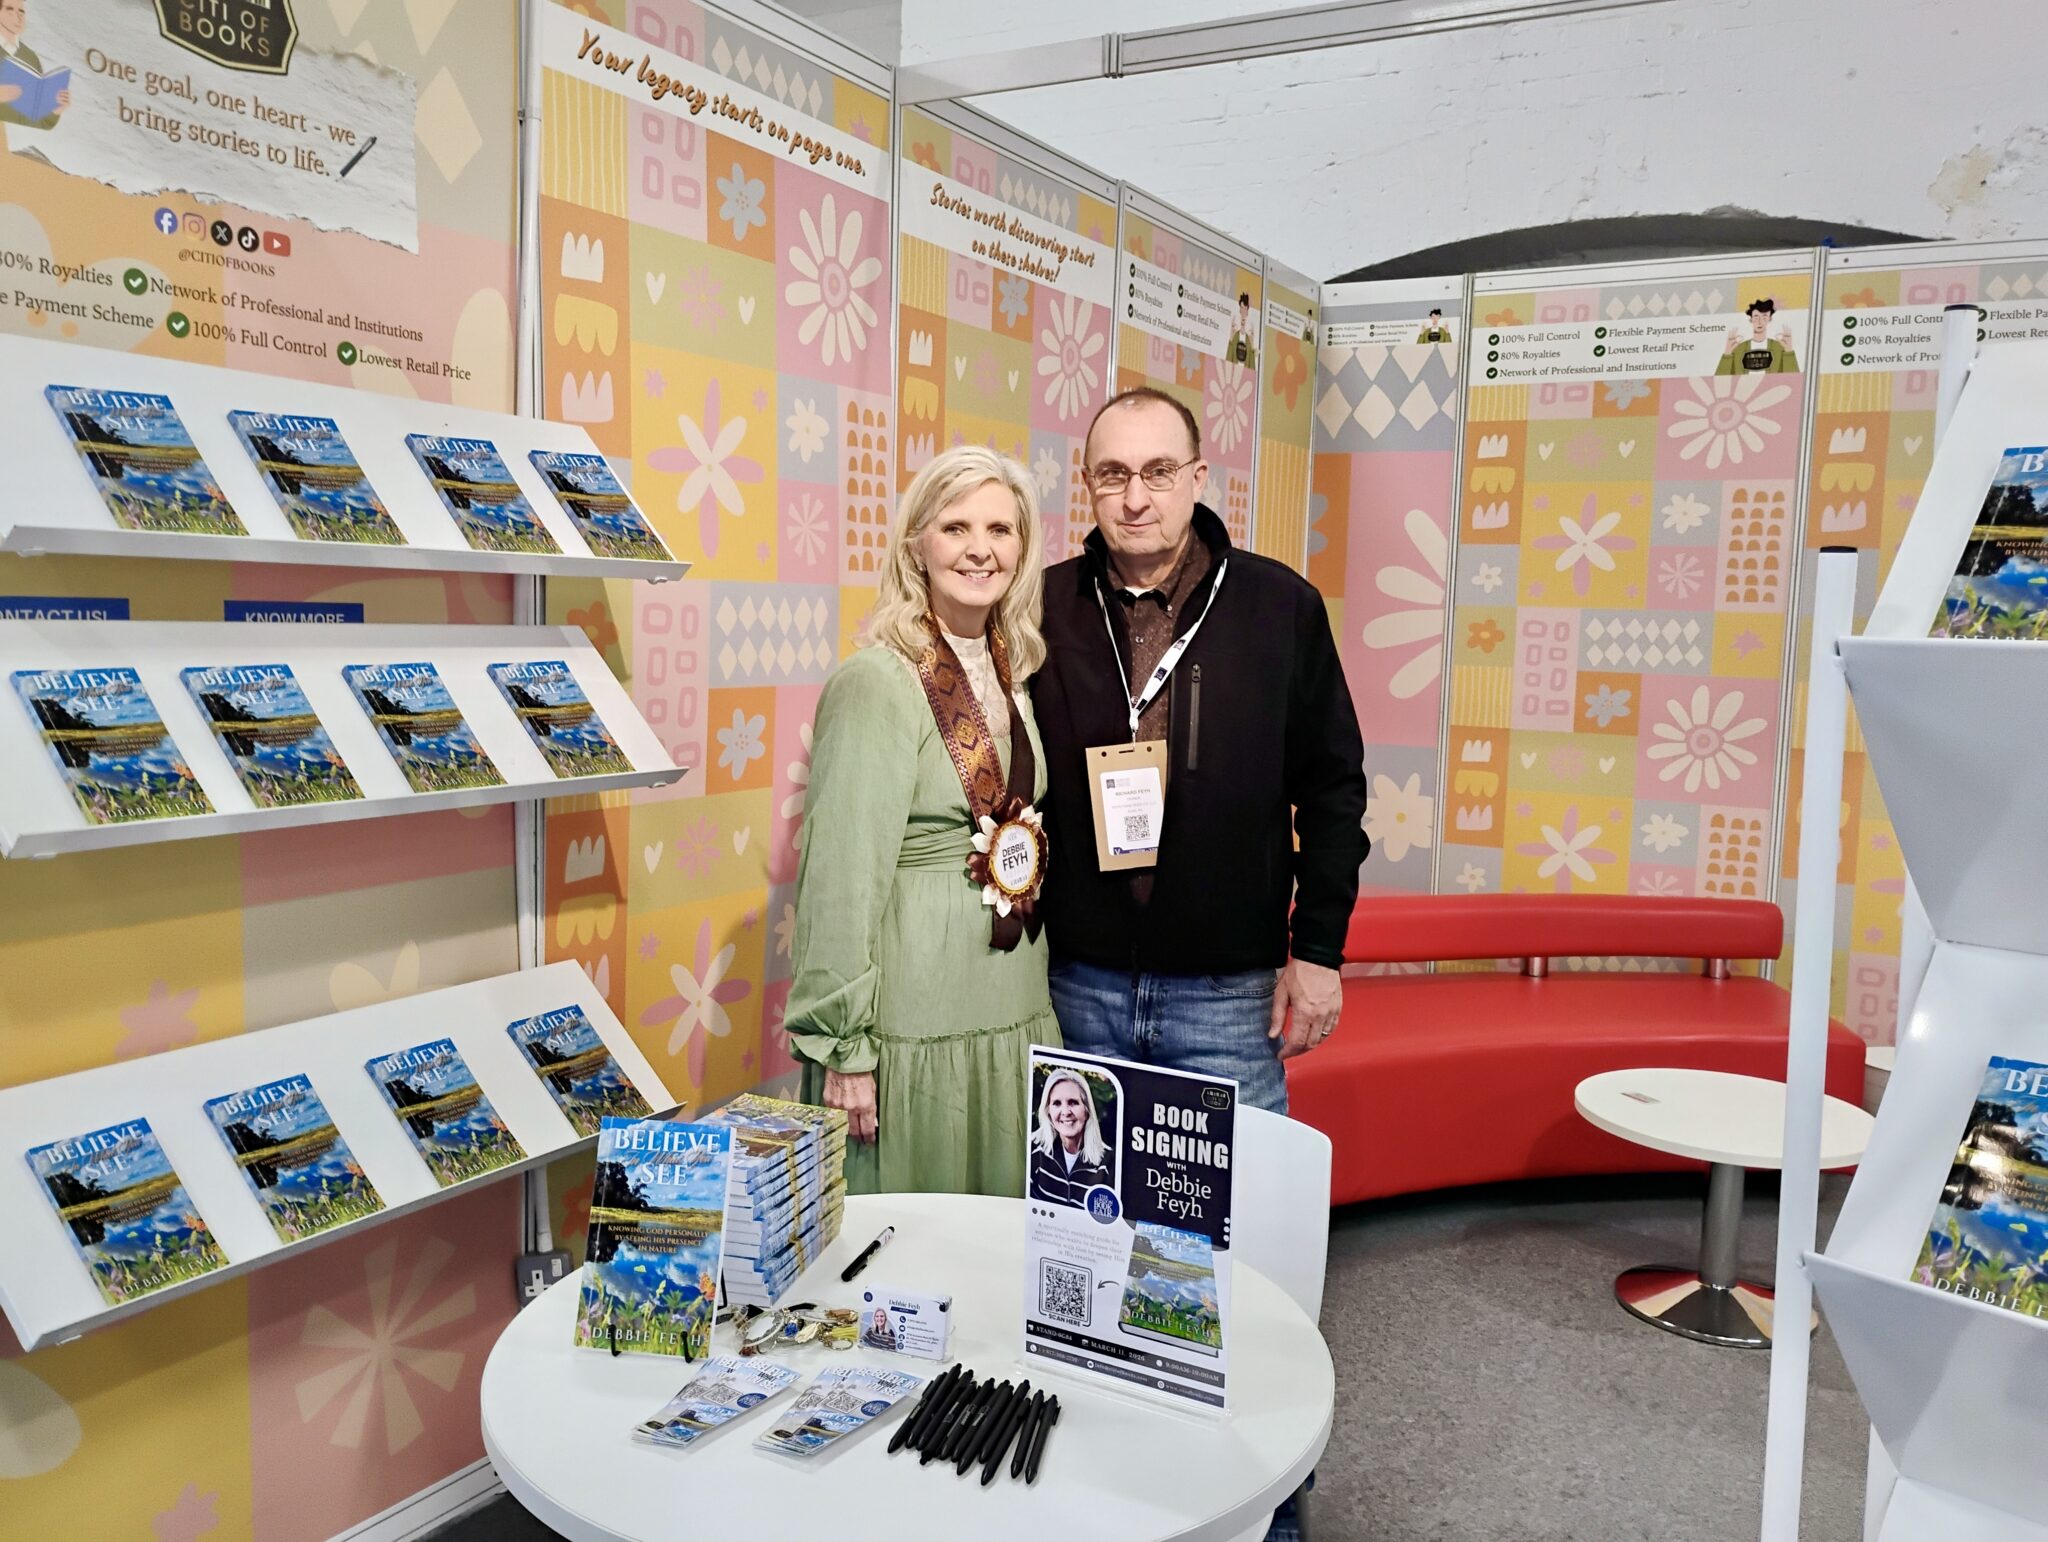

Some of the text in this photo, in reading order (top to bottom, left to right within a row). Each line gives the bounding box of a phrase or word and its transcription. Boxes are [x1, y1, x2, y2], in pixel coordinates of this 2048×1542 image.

[240, 10, 269, 33] OF
[180, 11, 270, 57] BOOKS
[84, 47, 136, 83] One
[145, 71, 198, 104] goal,
[206, 89, 246, 115] one
[253, 96, 307, 133] heart
[328, 124, 356, 146] we
[577, 28, 867, 177] Your legacy starts on page one.
[118, 97, 330, 177] bring stories to life.
[930, 182, 1096, 268] Stories worth discovering start
[39, 258, 113, 286] Royalties
[178, 248, 276, 276] @CITIOFBOOKS
[972, 239, 1061, 283] on these shelves!
[14, 290, 88, 317] Payment
[92, 303, 154, 329] Scheme
[150, 277, 423, 342] Network of Professional and Institutions
[1860, 314, 1943, 327] 100% Full Contr
[1990, 309, 2032, 320] Flexible
[193, 320, 327, 358] 100% Full Control
[1501, 331, 1580, 344] 100% Full Control
[1609, 323, 1726, 338] Flexible Payment Scheme
[1858, 333, 1931, 346] 80% Royalties
[1989, 330, 2026, 339] Lowest
[1500, 350, 1560, 361] 80% Royalties
[1608, 343, 1695, 355] Lowest Retail Price
[1857, 352, 1902, 364] Network
[1905, 352, 1918, 362] of
[359, 350, 471, 380] Lowest Retail Price
[1500, 362, 1677, 377] Network of Professional and Institutions
[66, 391, 167, 412] BELIEVE
[248, 415, 334, 434] BELIEVE
[421, 437, 491, 454] BELIEVE
[33, 671, 136, 690] BELIEVE
[200, 667, 287, 685] BELIEVE
[360, 666, 433, 682] BELIEVE
[503, 664, 564, 678] BELIEVE
[1002, 842, 1026, 858] DEBBIE
[1002, 850, 1029, 871] FEYH
[522, 1008, 579, 1036] BELIEVE
[383, 1042, 453, 1073] BELIEVE
[222, 1079, 308, 1115] BELIEVE
[257, 1107, 298, 1130] SEE
[1153, 1103, 1208, 1135] BOOK
[45, 1123, 145, 1164] BELIEVE
[615, 1128, 720, 1154] BELIEVE
[1131, 1126, 1229, 1169] SIGNING
[84, 1154, 131, 1180] SEE
[640, 1162, 688, 1186] SEE
[1166, 1161, 1187, 1171] WITH
[1146, 1168, 1212, 1199] Debbie
[1157, 1190, 1203, 1219] Feyh
[608, 1225, 709, 1238] KNOWING GOD PERSONALLY
[648, 1245, 678, 1253] NATURE
[889, 1299, 907, 1308] Debbie
[1935, 1277, 2022, 1313] DEBBIE
[1048, 1313, 1081, 1327] SCAN HERE
[1131, 1311, 1211, 1337] DEBBIE FEYH
[592, 1326, 702, 1347] DEBBIE FEH
[1091, 1341, 1116, 1354] MARCH
